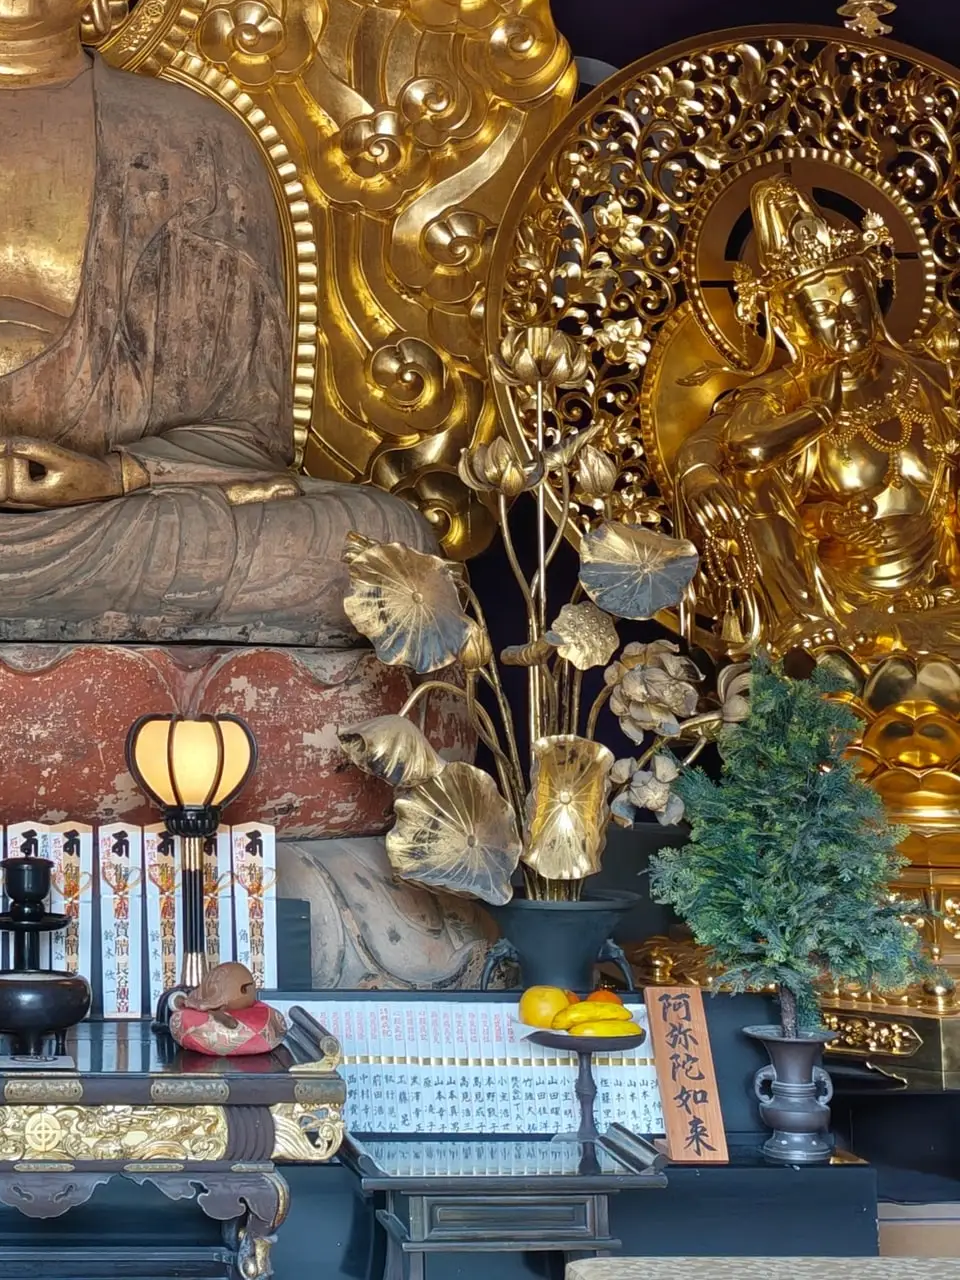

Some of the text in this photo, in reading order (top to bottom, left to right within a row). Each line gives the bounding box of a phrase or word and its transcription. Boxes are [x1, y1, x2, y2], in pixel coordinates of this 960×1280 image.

[658, 992, 717, 1156] 阿弥陀如来
